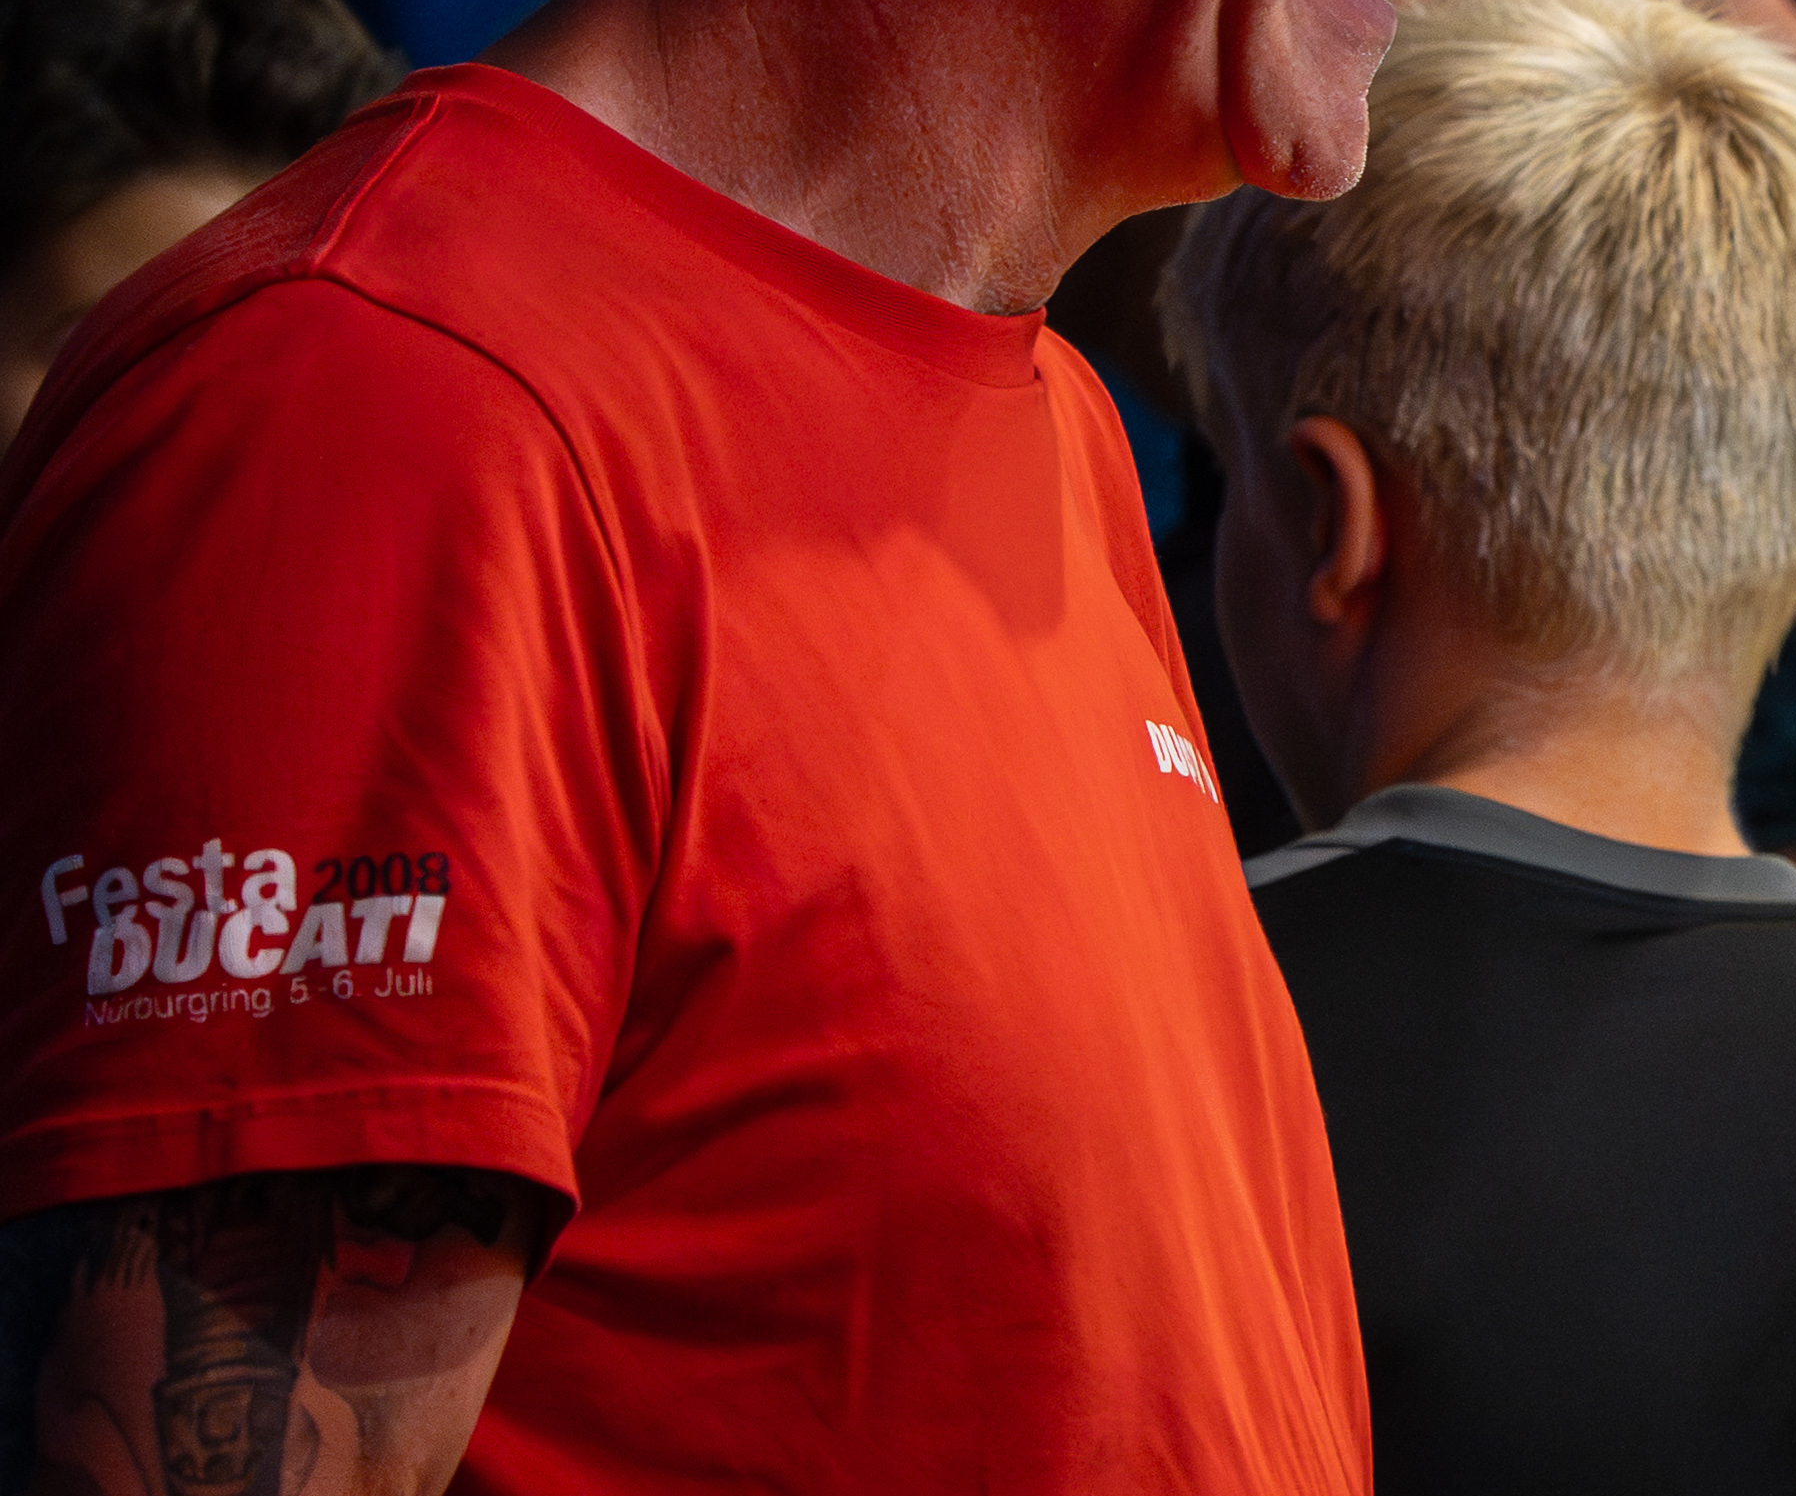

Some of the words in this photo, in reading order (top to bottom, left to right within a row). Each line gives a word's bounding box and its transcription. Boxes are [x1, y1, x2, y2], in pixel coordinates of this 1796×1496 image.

[41, 837, 298, 946] Festa
[312, 851, 450, 905] 2008
[86, 893, 447, 996] DUCATI
[374, 966, 433, 998] Juli
